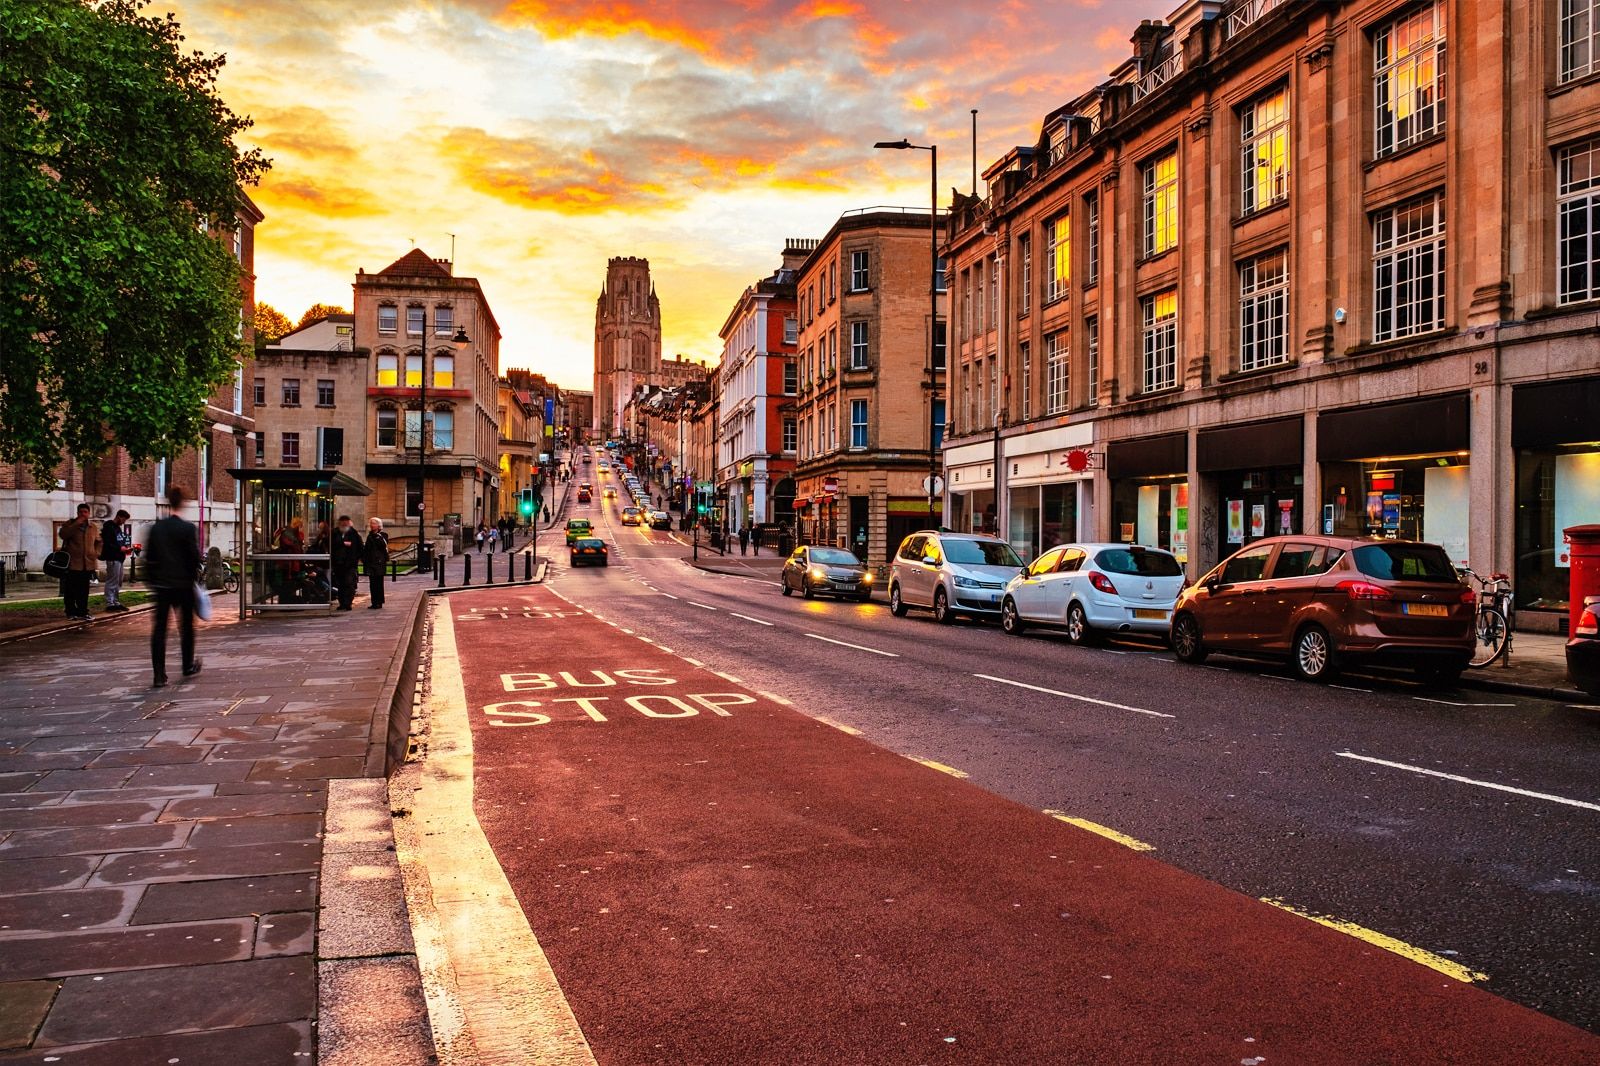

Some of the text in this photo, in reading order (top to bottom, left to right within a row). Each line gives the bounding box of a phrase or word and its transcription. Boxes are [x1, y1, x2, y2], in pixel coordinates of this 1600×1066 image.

[1474, 361, 1488, 376] 28
[457, 611, 584, 621] STOP
[499, 669, 678, 692] BUS
[482, 692, 757, 726] STOP
